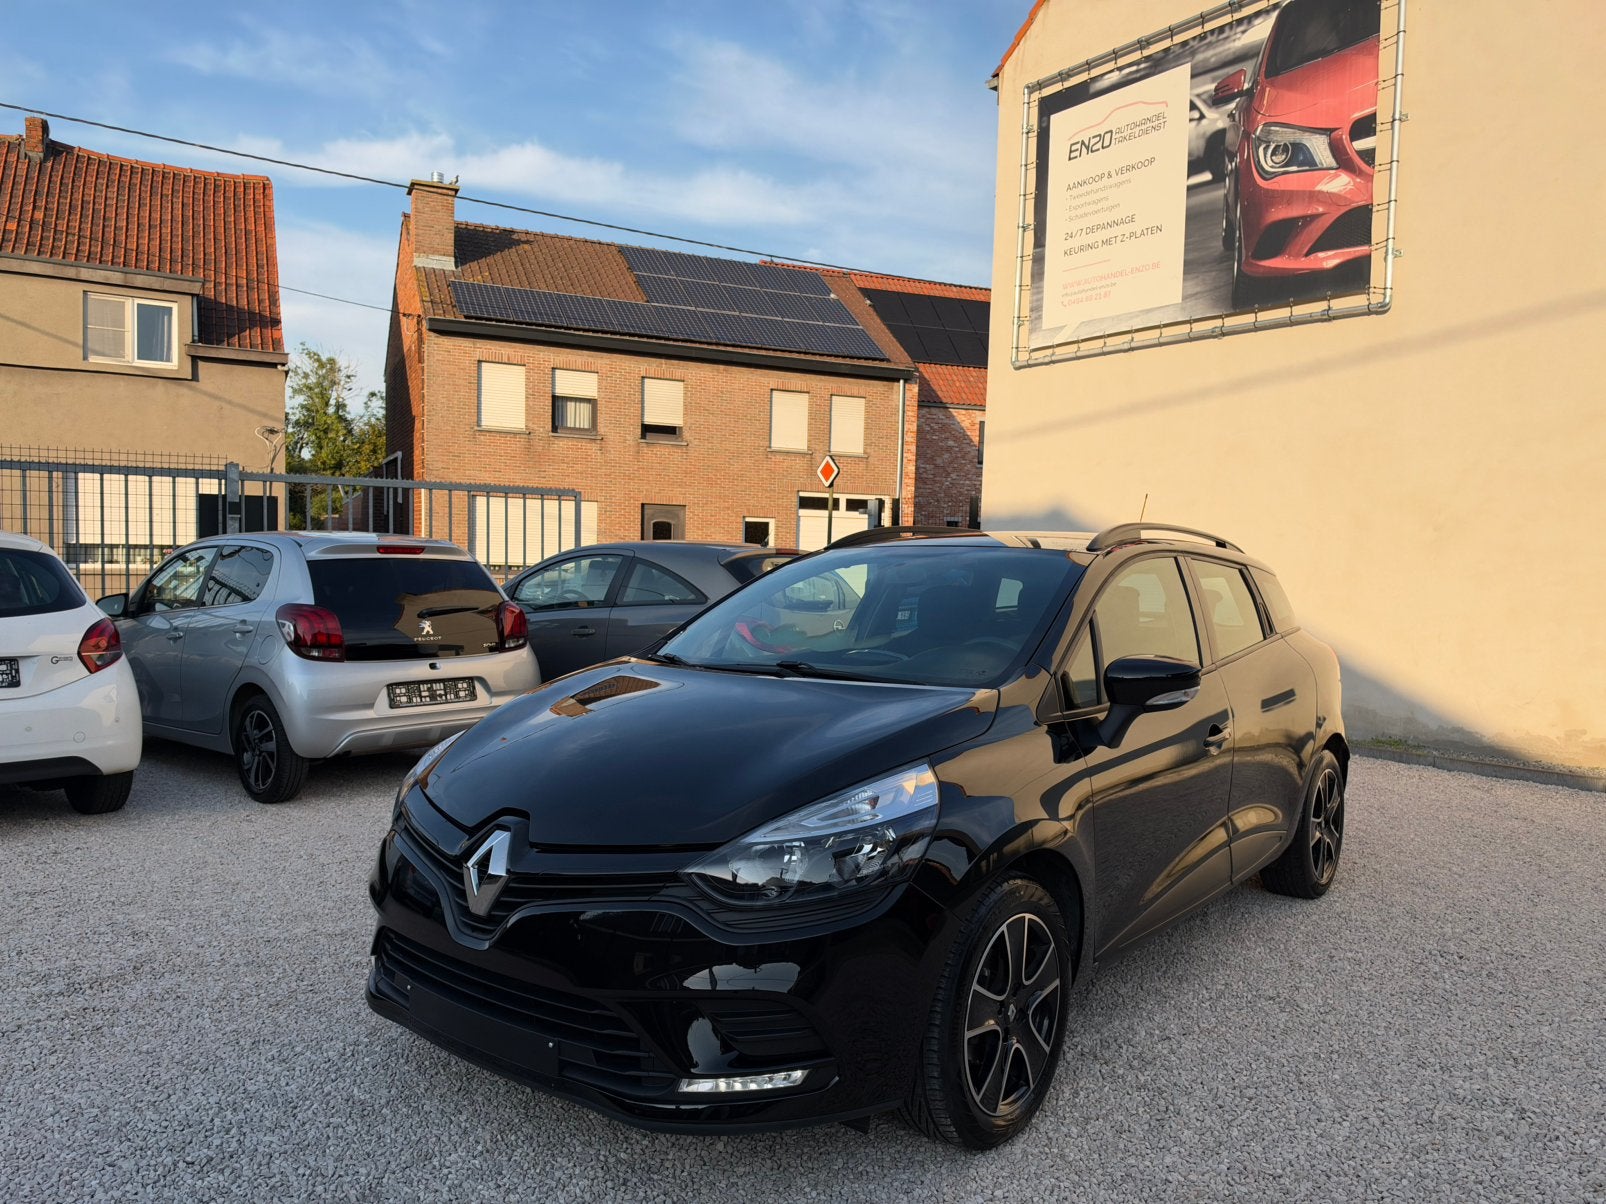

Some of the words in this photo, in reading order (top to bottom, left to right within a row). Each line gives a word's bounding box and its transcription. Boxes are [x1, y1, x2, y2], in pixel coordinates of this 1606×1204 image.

[1113, 120, 1168, 146] TAKELDIENST
[1114, 112, 1168, 135] AUTOHANDEL
[1068, 129, 1114, 161] ENZO
[1066, 172, 1106, 192] AANKOOP
[1107, 170, 1113, 179] &
[1114, 156, 1156, 176] VERKOOP
[1063, 241, 1100, 257] KEURING
[1101, 236, 1119, 249] MET
[1120, 224, 1163, 243] Z-PLATEN
[1064, 228, 1085, 241] 24/7
[1085, 214, 1136, 236] DEPANNAGE
